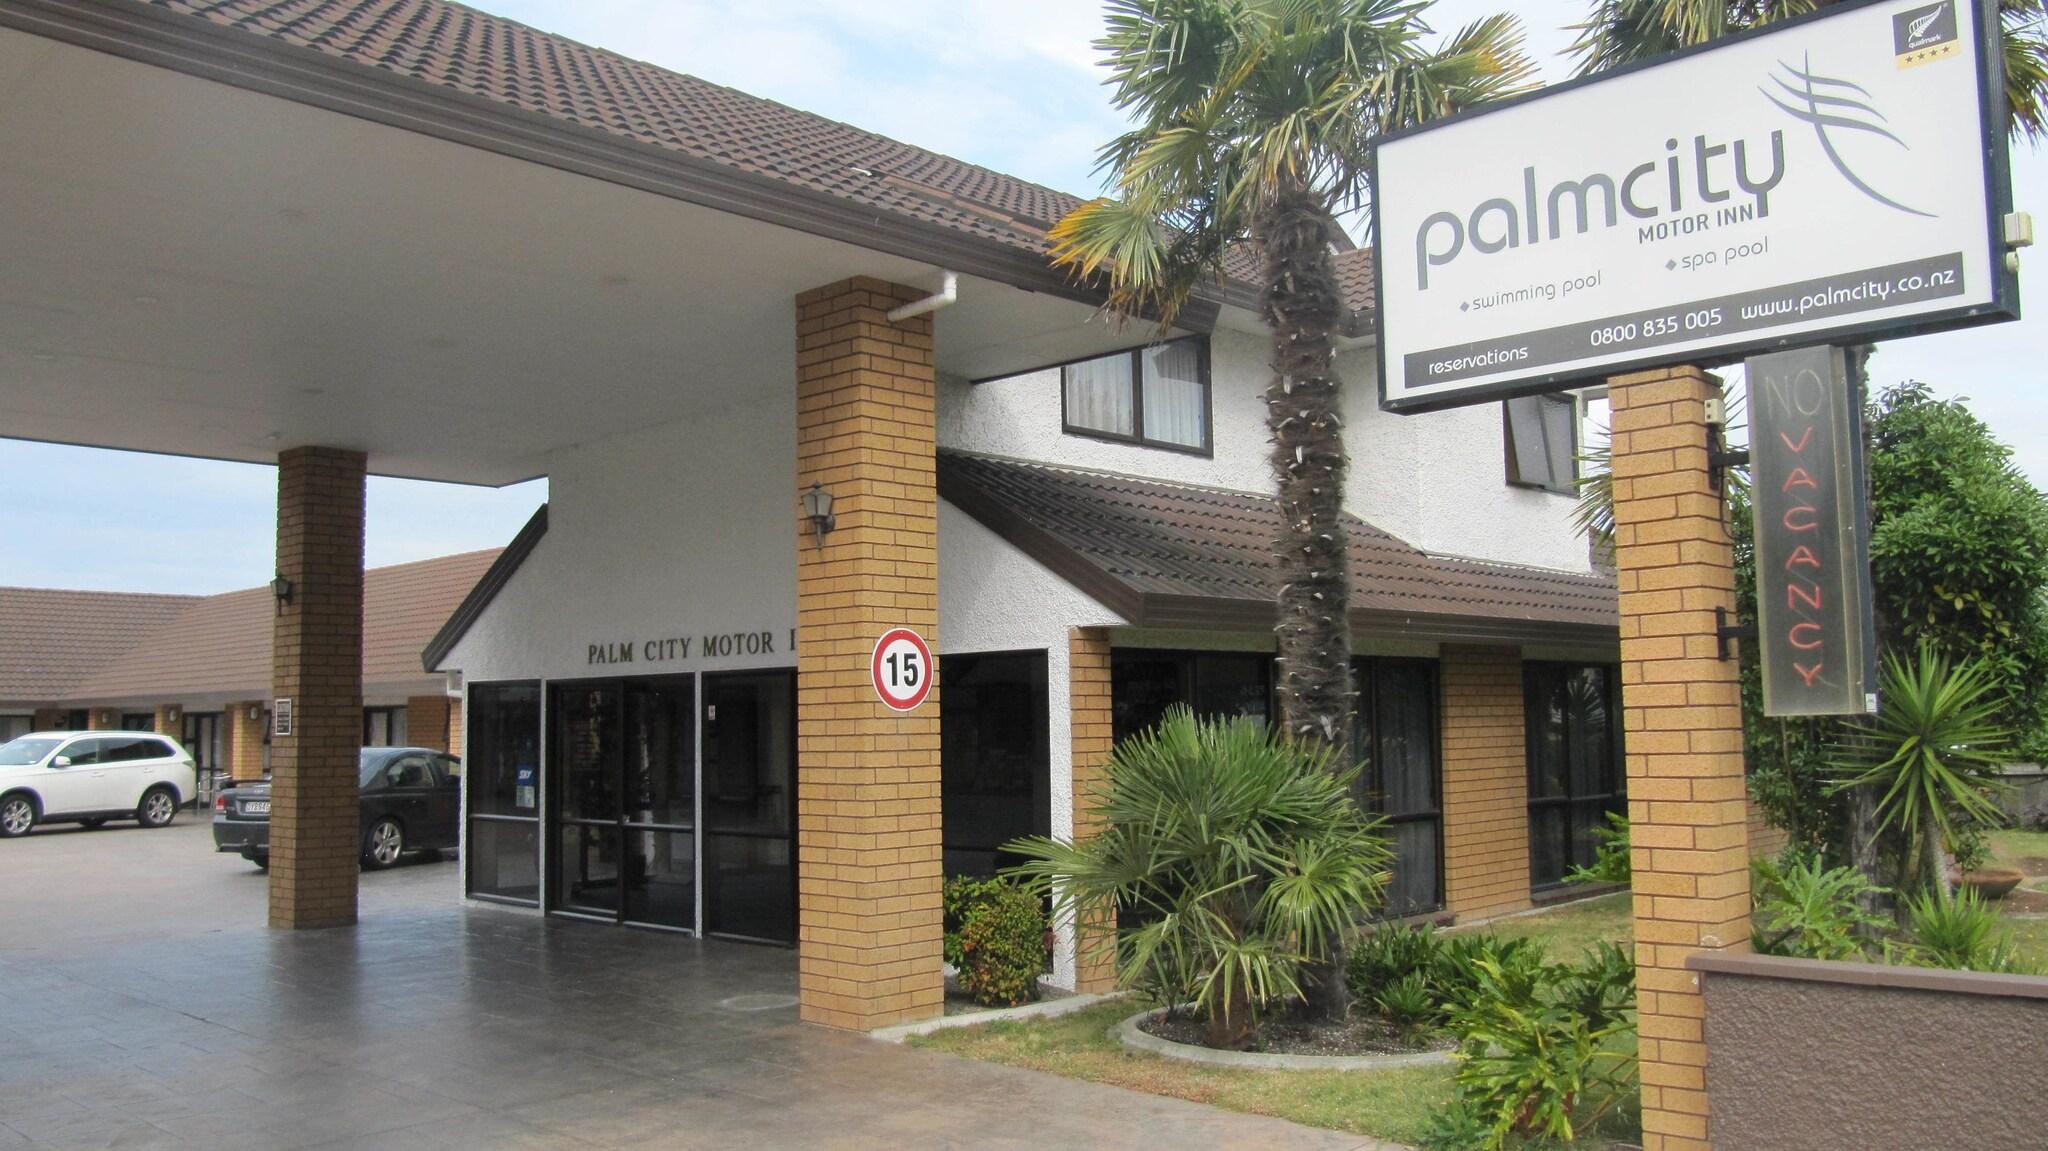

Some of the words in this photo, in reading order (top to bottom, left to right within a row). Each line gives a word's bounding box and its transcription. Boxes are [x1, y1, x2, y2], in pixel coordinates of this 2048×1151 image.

[1908, 33, 1941, 49] qualmark
[1416, 130, 1785, 291] palmcity
[1638, 213, 1709, 244] MOTOR
[1717, 203, 1754, 227] INN
[1681, 251, 1717, 271] spa
[1725, 236, 1769, 265] pool
[1472, 282, 1556, 311] swimming
[1562, 270, 1601, 297] pool
[1428, 346, 1529, 375] reservations
[1590, 323, 1637, 347] 0800
[1642, 315, 1679, 338] 835
[1684, 308, 1722, 331] 005
[1740, 268, 1955, 321] www.palmcity.co.nz
[1764, 369, 1825, 420] NO
[1780, 426, 1825, 688] VACANCY
[588, 642, 633, 664] PALM
[644, 637, 691, 660] CITY
[703, 631, 774, 657] MOTOR
[886, 652, 919, 688] 15
